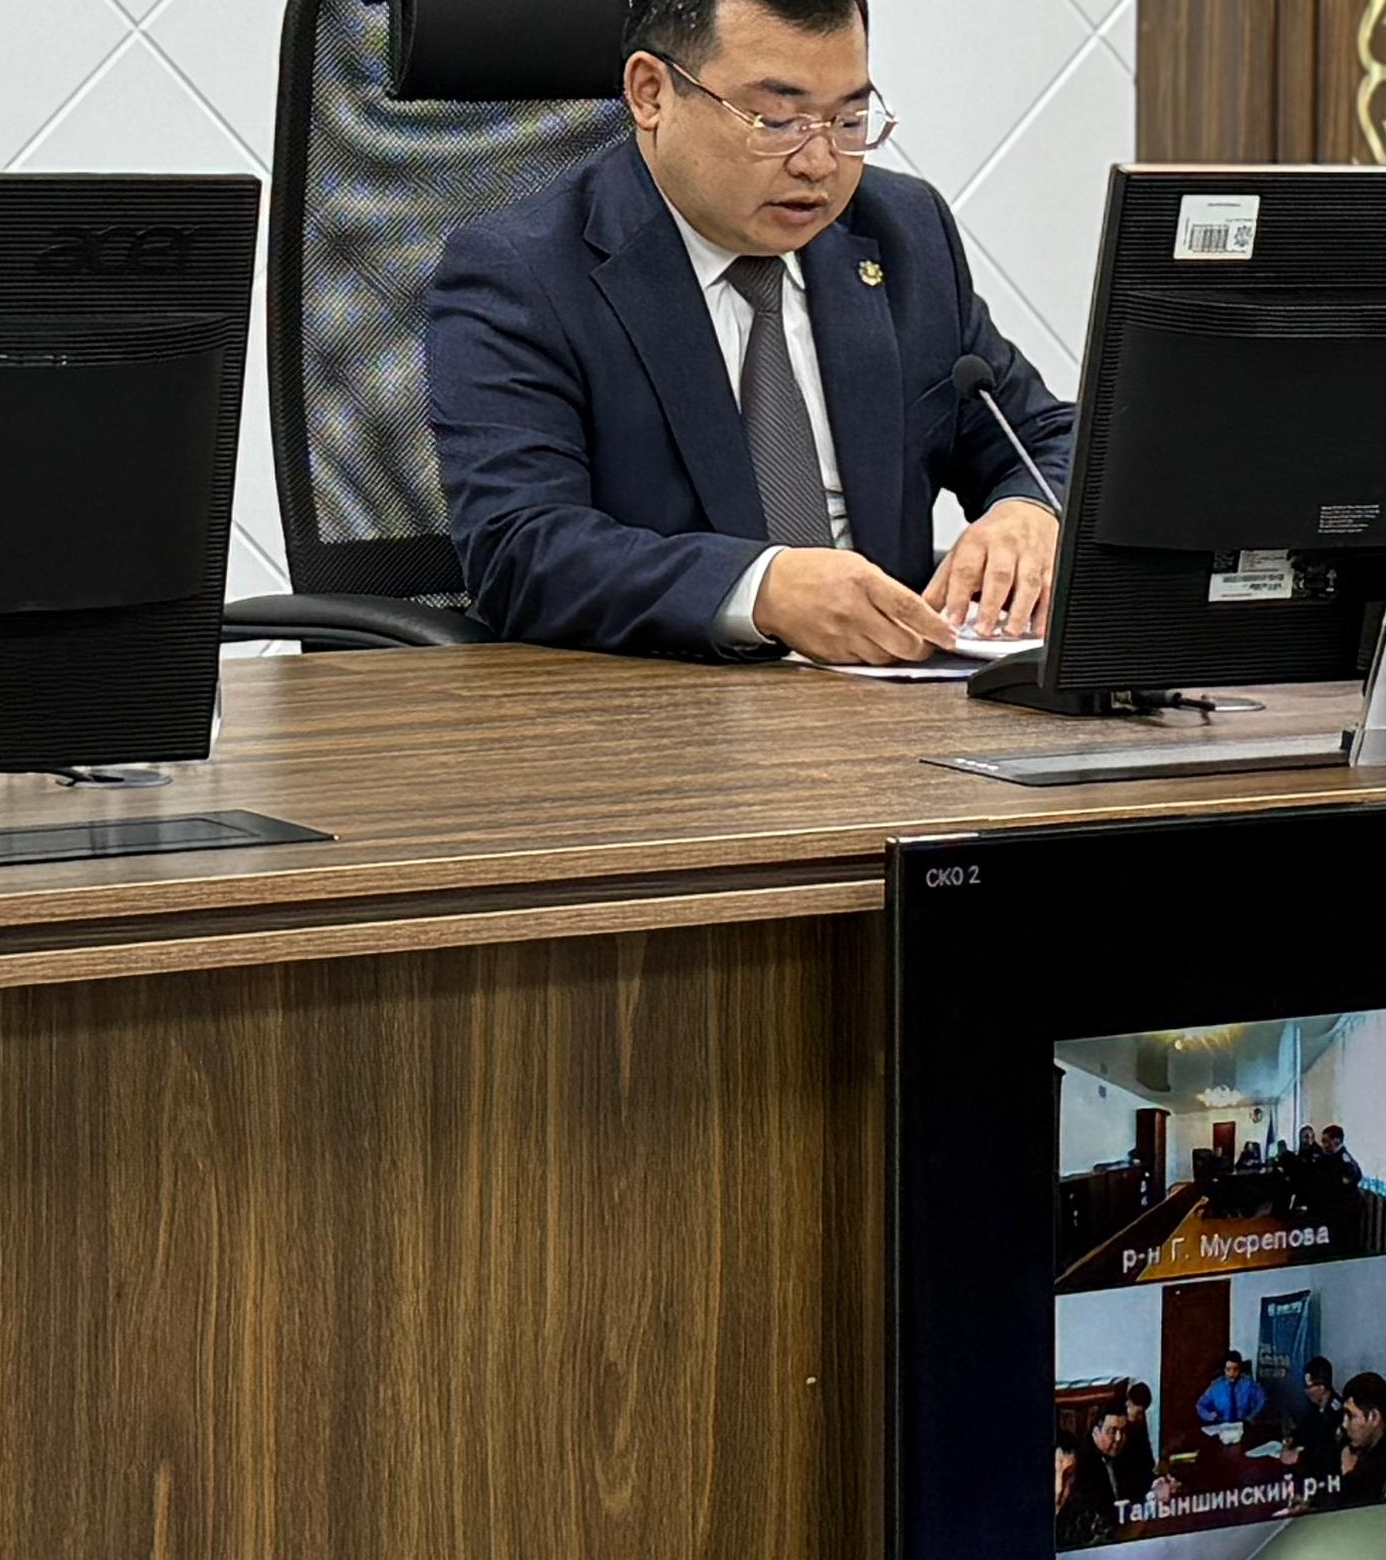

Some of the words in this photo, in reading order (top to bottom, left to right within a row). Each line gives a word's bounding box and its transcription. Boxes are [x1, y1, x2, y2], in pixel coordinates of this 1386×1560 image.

[925, 866, 964, 888] СКО
[968, 864, 981, 884] 2
[1122, 1245, 1161, 1274] р-н
[1171, 1236, 1190, 1262] Г.
[1199, 1225, 1330, 1263] Мусрепова
[1114, 1473, 1295, 1525] Тайыншинский
[1303, 1474, 1341, 1501] р-н
